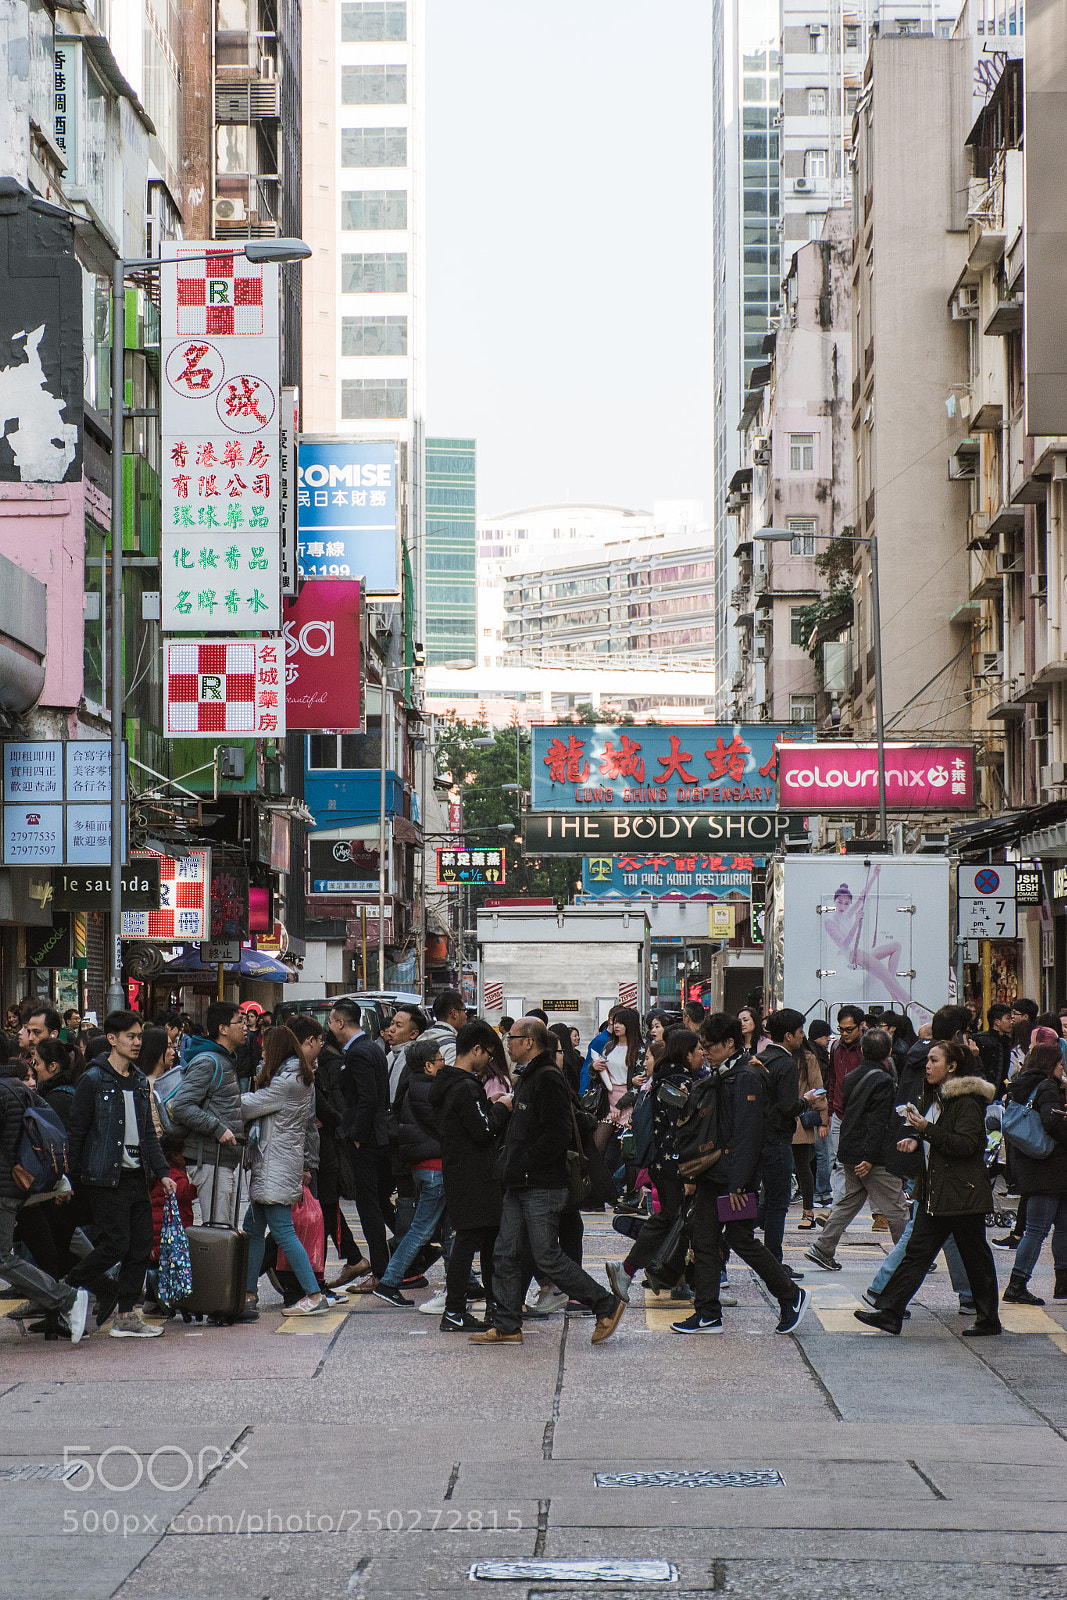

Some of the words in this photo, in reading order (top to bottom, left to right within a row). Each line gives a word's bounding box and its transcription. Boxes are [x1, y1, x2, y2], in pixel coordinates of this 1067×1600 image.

[170, 440, 271, 469] 香港藥房
[171, 473, 271, 499] 有限公司
[174, 588, 269, 615] 名牌香水
[258, 644, 279, 732] 名城藥房
[10, 751, 55, 762] 即租即用
[73, 750, 111, 761] 合寫字
[951, 757, 967, 795] 卡萊美
[10, 781, 56, 792] 歡迎查詢
[73, 781, 111, 792] 各行各
[575, 787, 613, 803] LUNG
[676, 787, 773, 802] DISPENSARY
[74, 821, 111, 832] 多種面
[547, 817, 600, 838] THE
[614, 817, 699, 838] BODY
[708, 817, 789, 838] SHOP
[11, 832, 56, 842] 27977535
[11, 846, 56, 856] 27977597
[63, 876, 78, 891] le
[623, 874, 638, 886] TAI
[642, 874, 663, 886] PING
[667, 874, 692, 886] KOON
[996, 902, 1005, 914] 7
[996, 923, 1005, 935] 7
[208, 948, 232, 959] 終止
